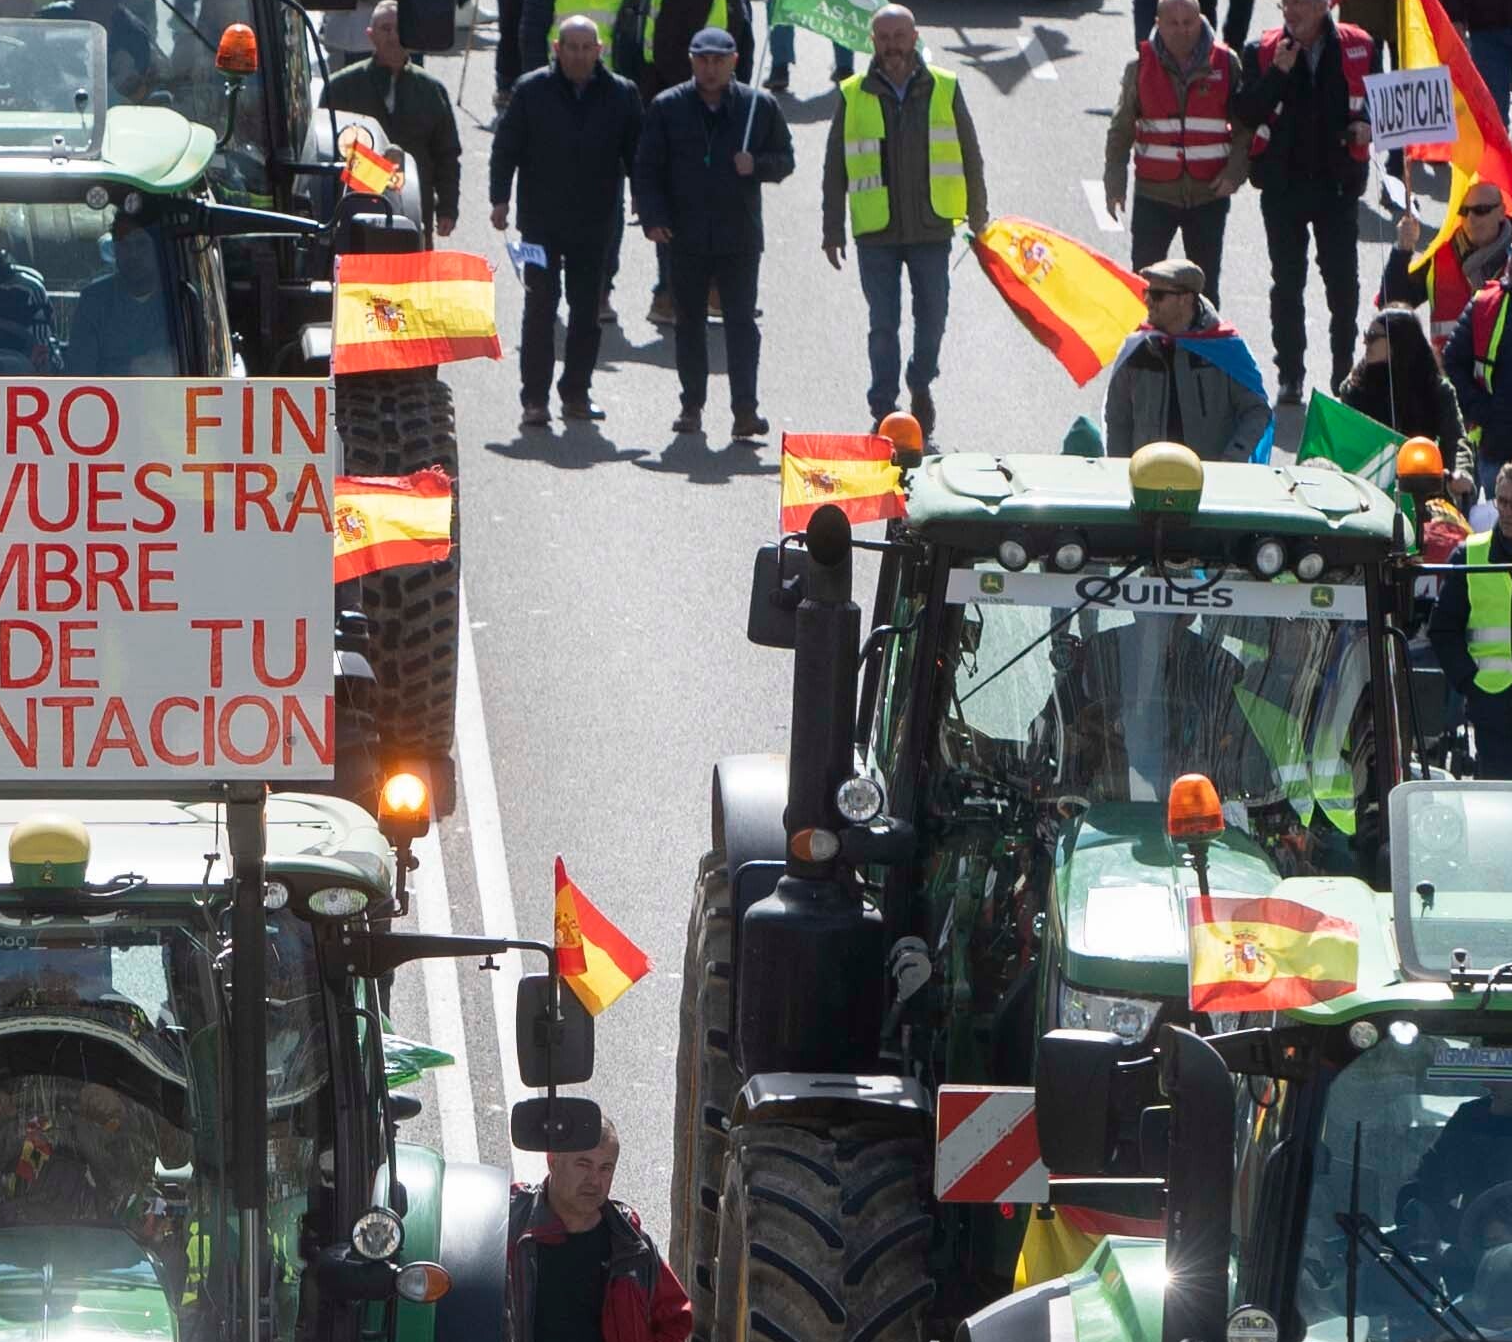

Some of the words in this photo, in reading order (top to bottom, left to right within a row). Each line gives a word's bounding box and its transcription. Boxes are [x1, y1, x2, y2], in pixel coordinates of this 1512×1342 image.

[1372, 79, 1451, 132] ¡JUSTICIA!
[183, 385, 330, 456] FIN
[1075, 576, 1233, 609] QUILES
[189, 619, 307, 689] TU
